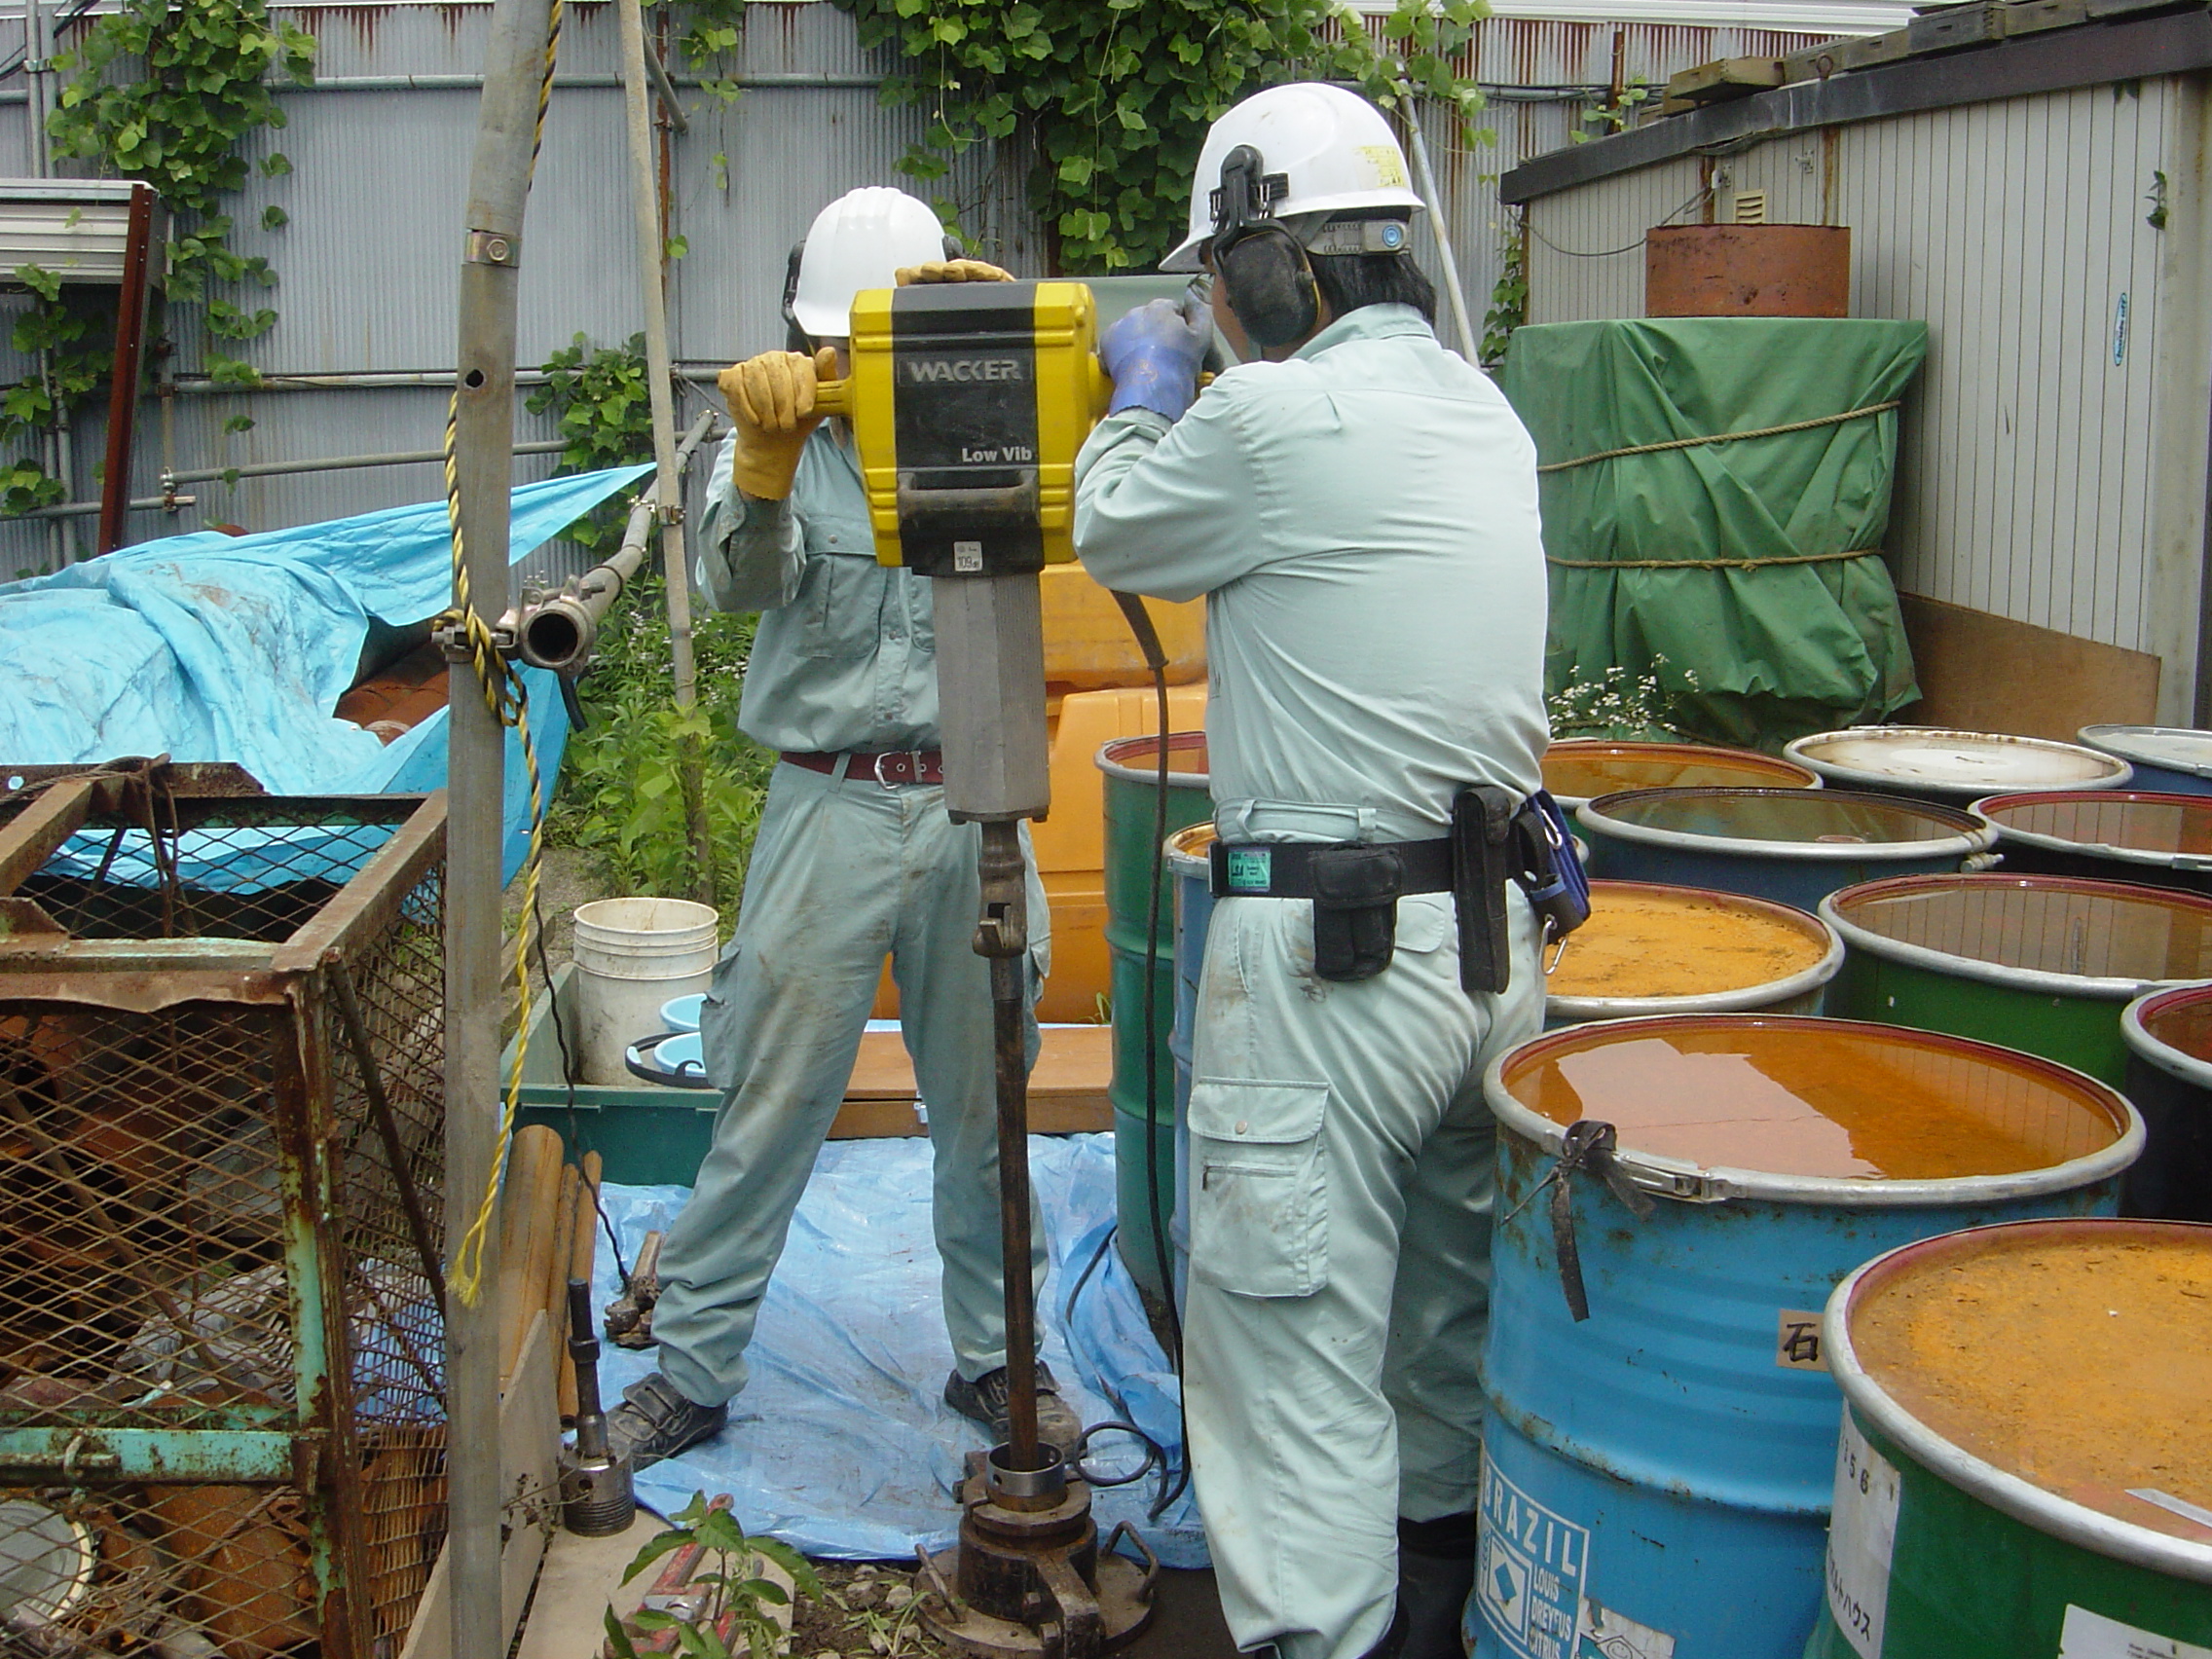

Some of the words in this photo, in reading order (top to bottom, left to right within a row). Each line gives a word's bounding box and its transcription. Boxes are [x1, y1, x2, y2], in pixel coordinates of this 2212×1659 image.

[906, 359, 1023, 383] WACKER
[961, 448, 998, 462] Low
[1002, 446, 1032, 461] Vib
[1783, 1322, 1820, 1363] 石
[1485, 1463, 1576, 1577] BRAZIL
[1532, 1564, 1560, 1603] LOUIS
